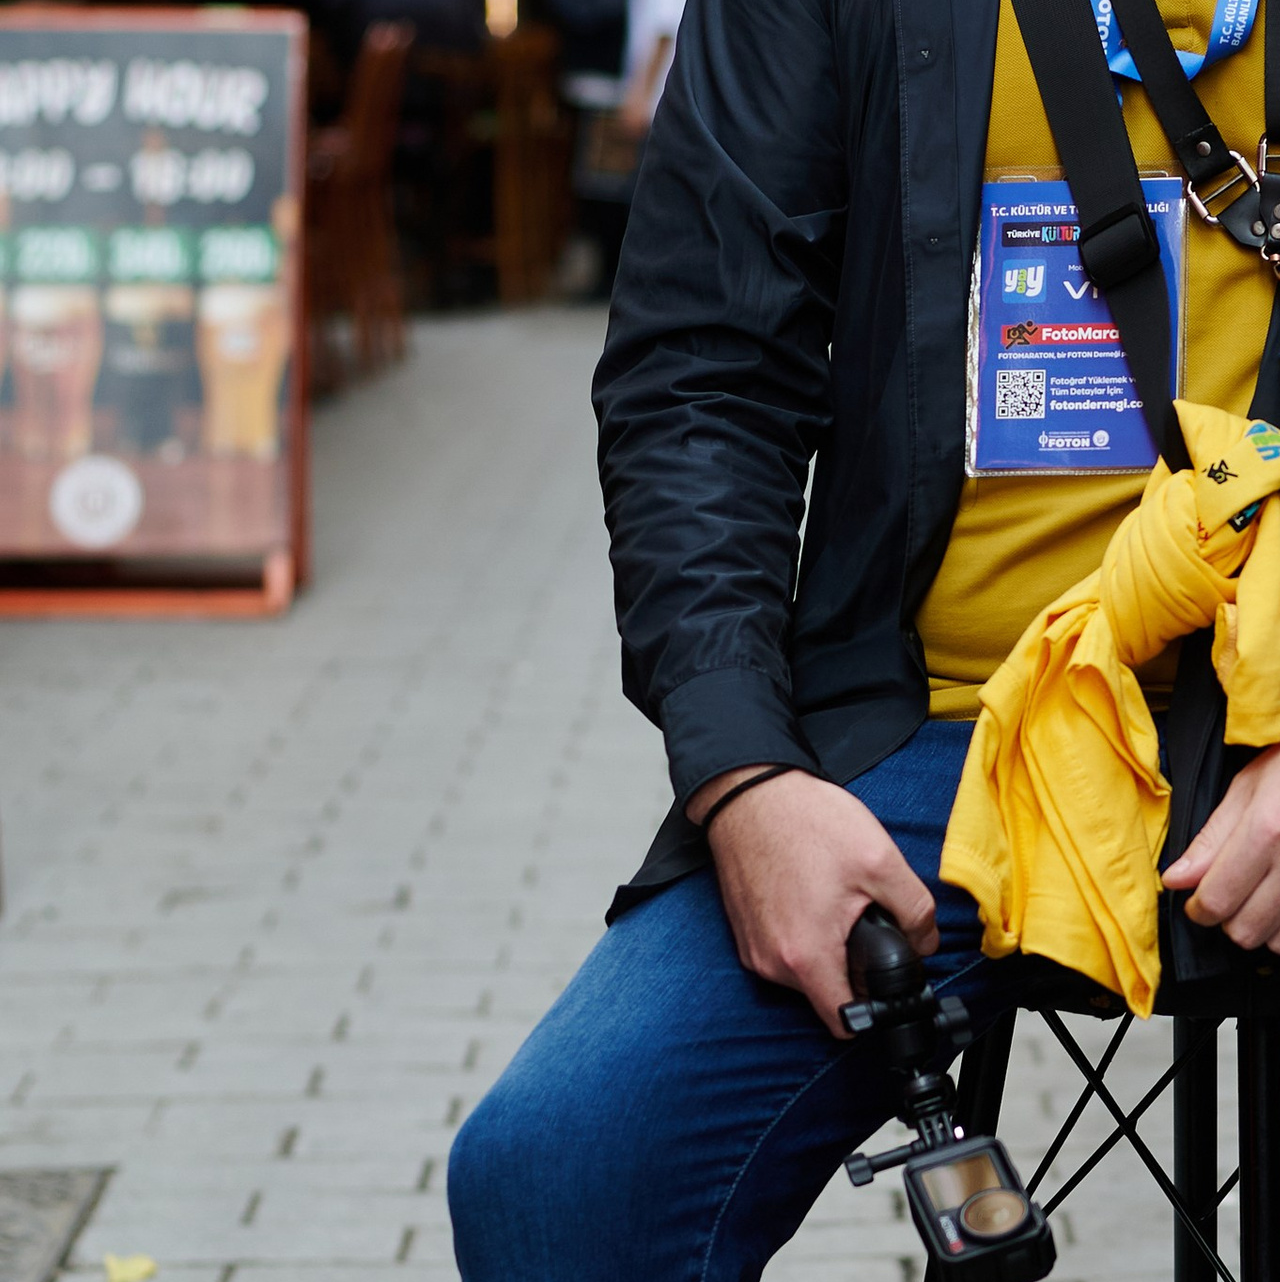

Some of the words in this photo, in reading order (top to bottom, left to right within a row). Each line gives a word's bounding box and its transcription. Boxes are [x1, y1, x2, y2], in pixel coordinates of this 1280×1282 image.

[991, 206, 1009, 217] T.C.
[1011, 205, 1051, 216] KÜLTÜR
[1053, 205, 1068, 215] VE
[1006, 228, 1041, 238] TÜRKİYE
[1041, 326, 1120, 341] FotoMara
[1067, 351, 1093, 359] FOTON
[1050, 376, 1087, 386] Fotoğraf
[1088, 375, 1128, 385] Yüklemek
[1050, 387, 1069, 396] Tüm
[1070, 387, 1106, 397] Detaylar
[1049, 398, 1143, 412] fotondernegi.co
[1048, 437, 1091, 448] FOTON
